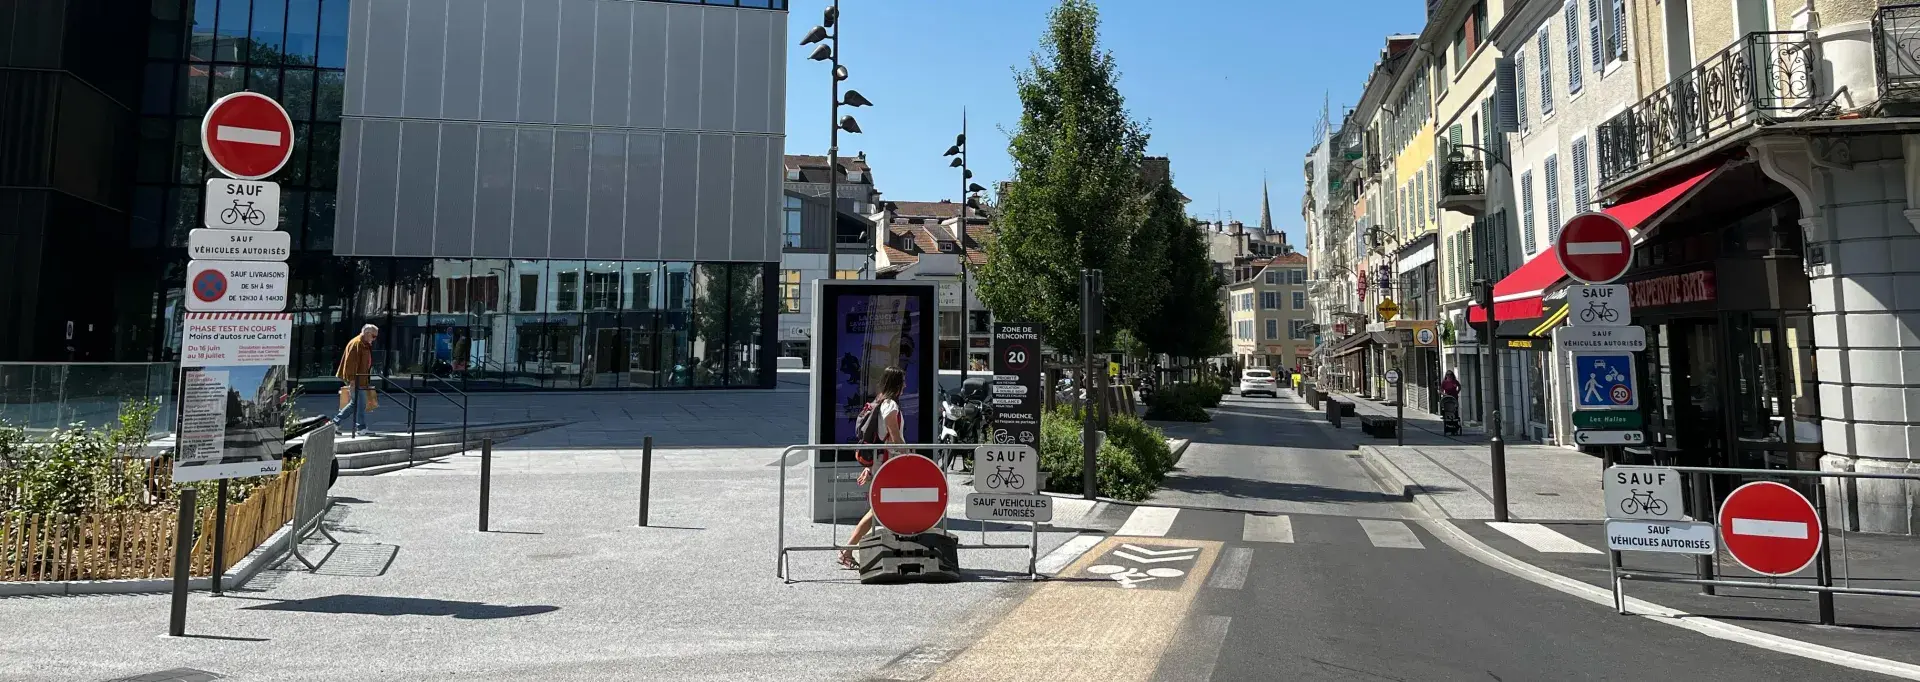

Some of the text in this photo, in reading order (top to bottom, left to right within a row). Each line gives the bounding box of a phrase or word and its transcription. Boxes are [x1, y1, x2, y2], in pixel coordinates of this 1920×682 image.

[227, 183, 264, 197] SAUF
[230, 235, 254, 243] SAUF
[194, 245, 286, 255] VÉHICULES AUTORISÉS
[231, 270, 286, 279] SAUF LIVRAISONS
[241, 282, 249, 290] DE
[1582, 287, 1614, 298] SAUF
[229, 294, 237, 302] DE
[1604, 339, 1643, 347] AUTORISÉS
[207, 345, 220, 353] juin
[205, 352, 225, 360] juillet
[1008, 351, 1026, 363] 20
[1614, 390, 1627, 399] 20
[999, 412, 1034, 420] PRUDENCE,
[986, 450, 1026, 462] SAUF
[1617, 472, 1666, 485] SAUF
[973, 498, 1047, 509] SAUF VEHICULES
[992, 507, 1035, 518] AUTORISÉS
[1647, 525, 1671, 535] SAUF
[1611, 535, 1711, 550] VÉHICULES AUTORISÉS
